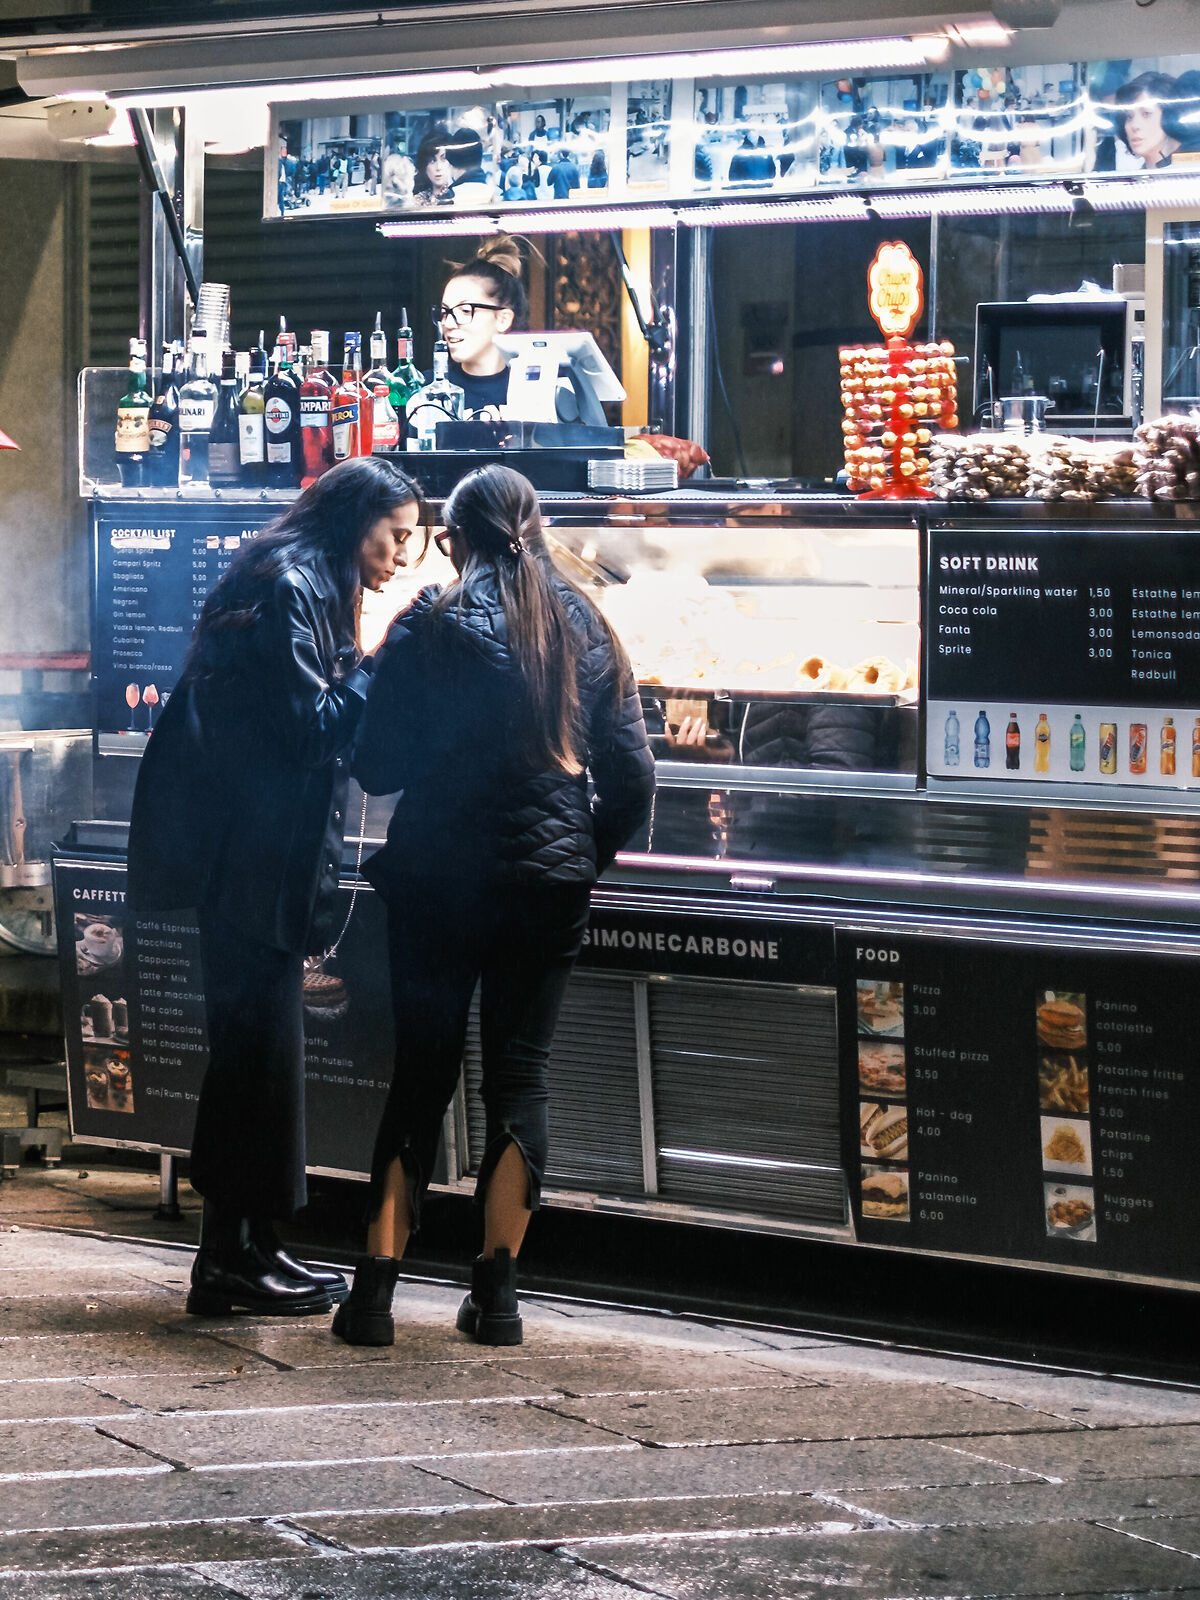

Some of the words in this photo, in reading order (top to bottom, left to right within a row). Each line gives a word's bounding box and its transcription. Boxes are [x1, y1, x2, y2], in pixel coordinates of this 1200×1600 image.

[111, 529, 155, 538] COCKTAIL
[157, 529, 176, 538] LIST
[112, 560, 141, 568] Campari
[142, 560, 162, 568] Spritz
[939, 556, 982, 571] SOFT
[985, 557, 1040, 572] DRINK
[112, 585, 149, 593] Americano
[939, 585, 1041, 598] Mineral/Sparkling
[1044, 587, 1079, 598] water
[1132, 588, 1178, 599] Estathe
[112, 598, 139, 607] Negroni
[938, 605, 969, 615] Coca
[972, 605, 998, 615] cola
[1132, 608, 1178, 619] Estathe
[112, 624, 133, 632] Vodka
[158, 625, 184, 633] Redbull
[938, 624, 971, 635] Fanta
[1131, 628, 1200, 641] Lemonsoda
[112, 636, 145, 644] Cubalibre
[112, 649, 144, 657] Prosecco
[938, 644, 972, 656] Sprite
[1131, 649, 1172, 660] Tonica
[112, 662, 128, 670] Vino
[129, 662, 173, 672] bianco/rosso
[1131, 669, 1177, 681] Redbull
[72, 888, 126, 903] CAFFETT
[161, 923, 201, 935] Espresso
[137, 938, 182, 949] Macchiato
[138, 954, 191, 967] Cappuccino
[856, 947, 900, 963] FOOD
[139, 971, 161, 980] Latte
[170, 974, 188, 983] Milk
[140, 988, 162, 997] Latte
[912, 984, 941, 995] Pizza
[158, 1007, 184, 1016] caldo
[1095, 1000, 1137, 1013] Panino
[142, 1021, 156, 1030] Hot
[159, 1023, 203, 1035] chocolate
[1096, 1022, 1153, 1034] cotoletta
[142, 1037, 157, 1047] Hot
[159, 1039, 202, 1052] chocolate
[143, 1053, 157, 1062] Vin
[914, 1046, 956, 1059] Stuffed
[960, 1051, 989, 1062] pizza
[322, 1057, 353, 1067] nutella
[1097, 1064, 1149, 1078] Patatine
[1153, 1069, 1184, 1081] fritte
[322, 1074, 354, 1085] nutella
[356, 1079, 374, 1087] and
[145, 1087, 182, 1098] Gin/Rum
[1142, 1087, 1169, 1099] fries
[916, 1107, 935, 1118] Hot
[950, 1110, 972, 1124] dog
[1100, 1128, 1151, 1142] Patatine
[1101, 1149, 1134, 1161] chips
[918, 1171, 958, 1184] Panino
[919, 1192, 977, 1205] salamella
[1104, 1193, 1154, 1208] Nuggets
